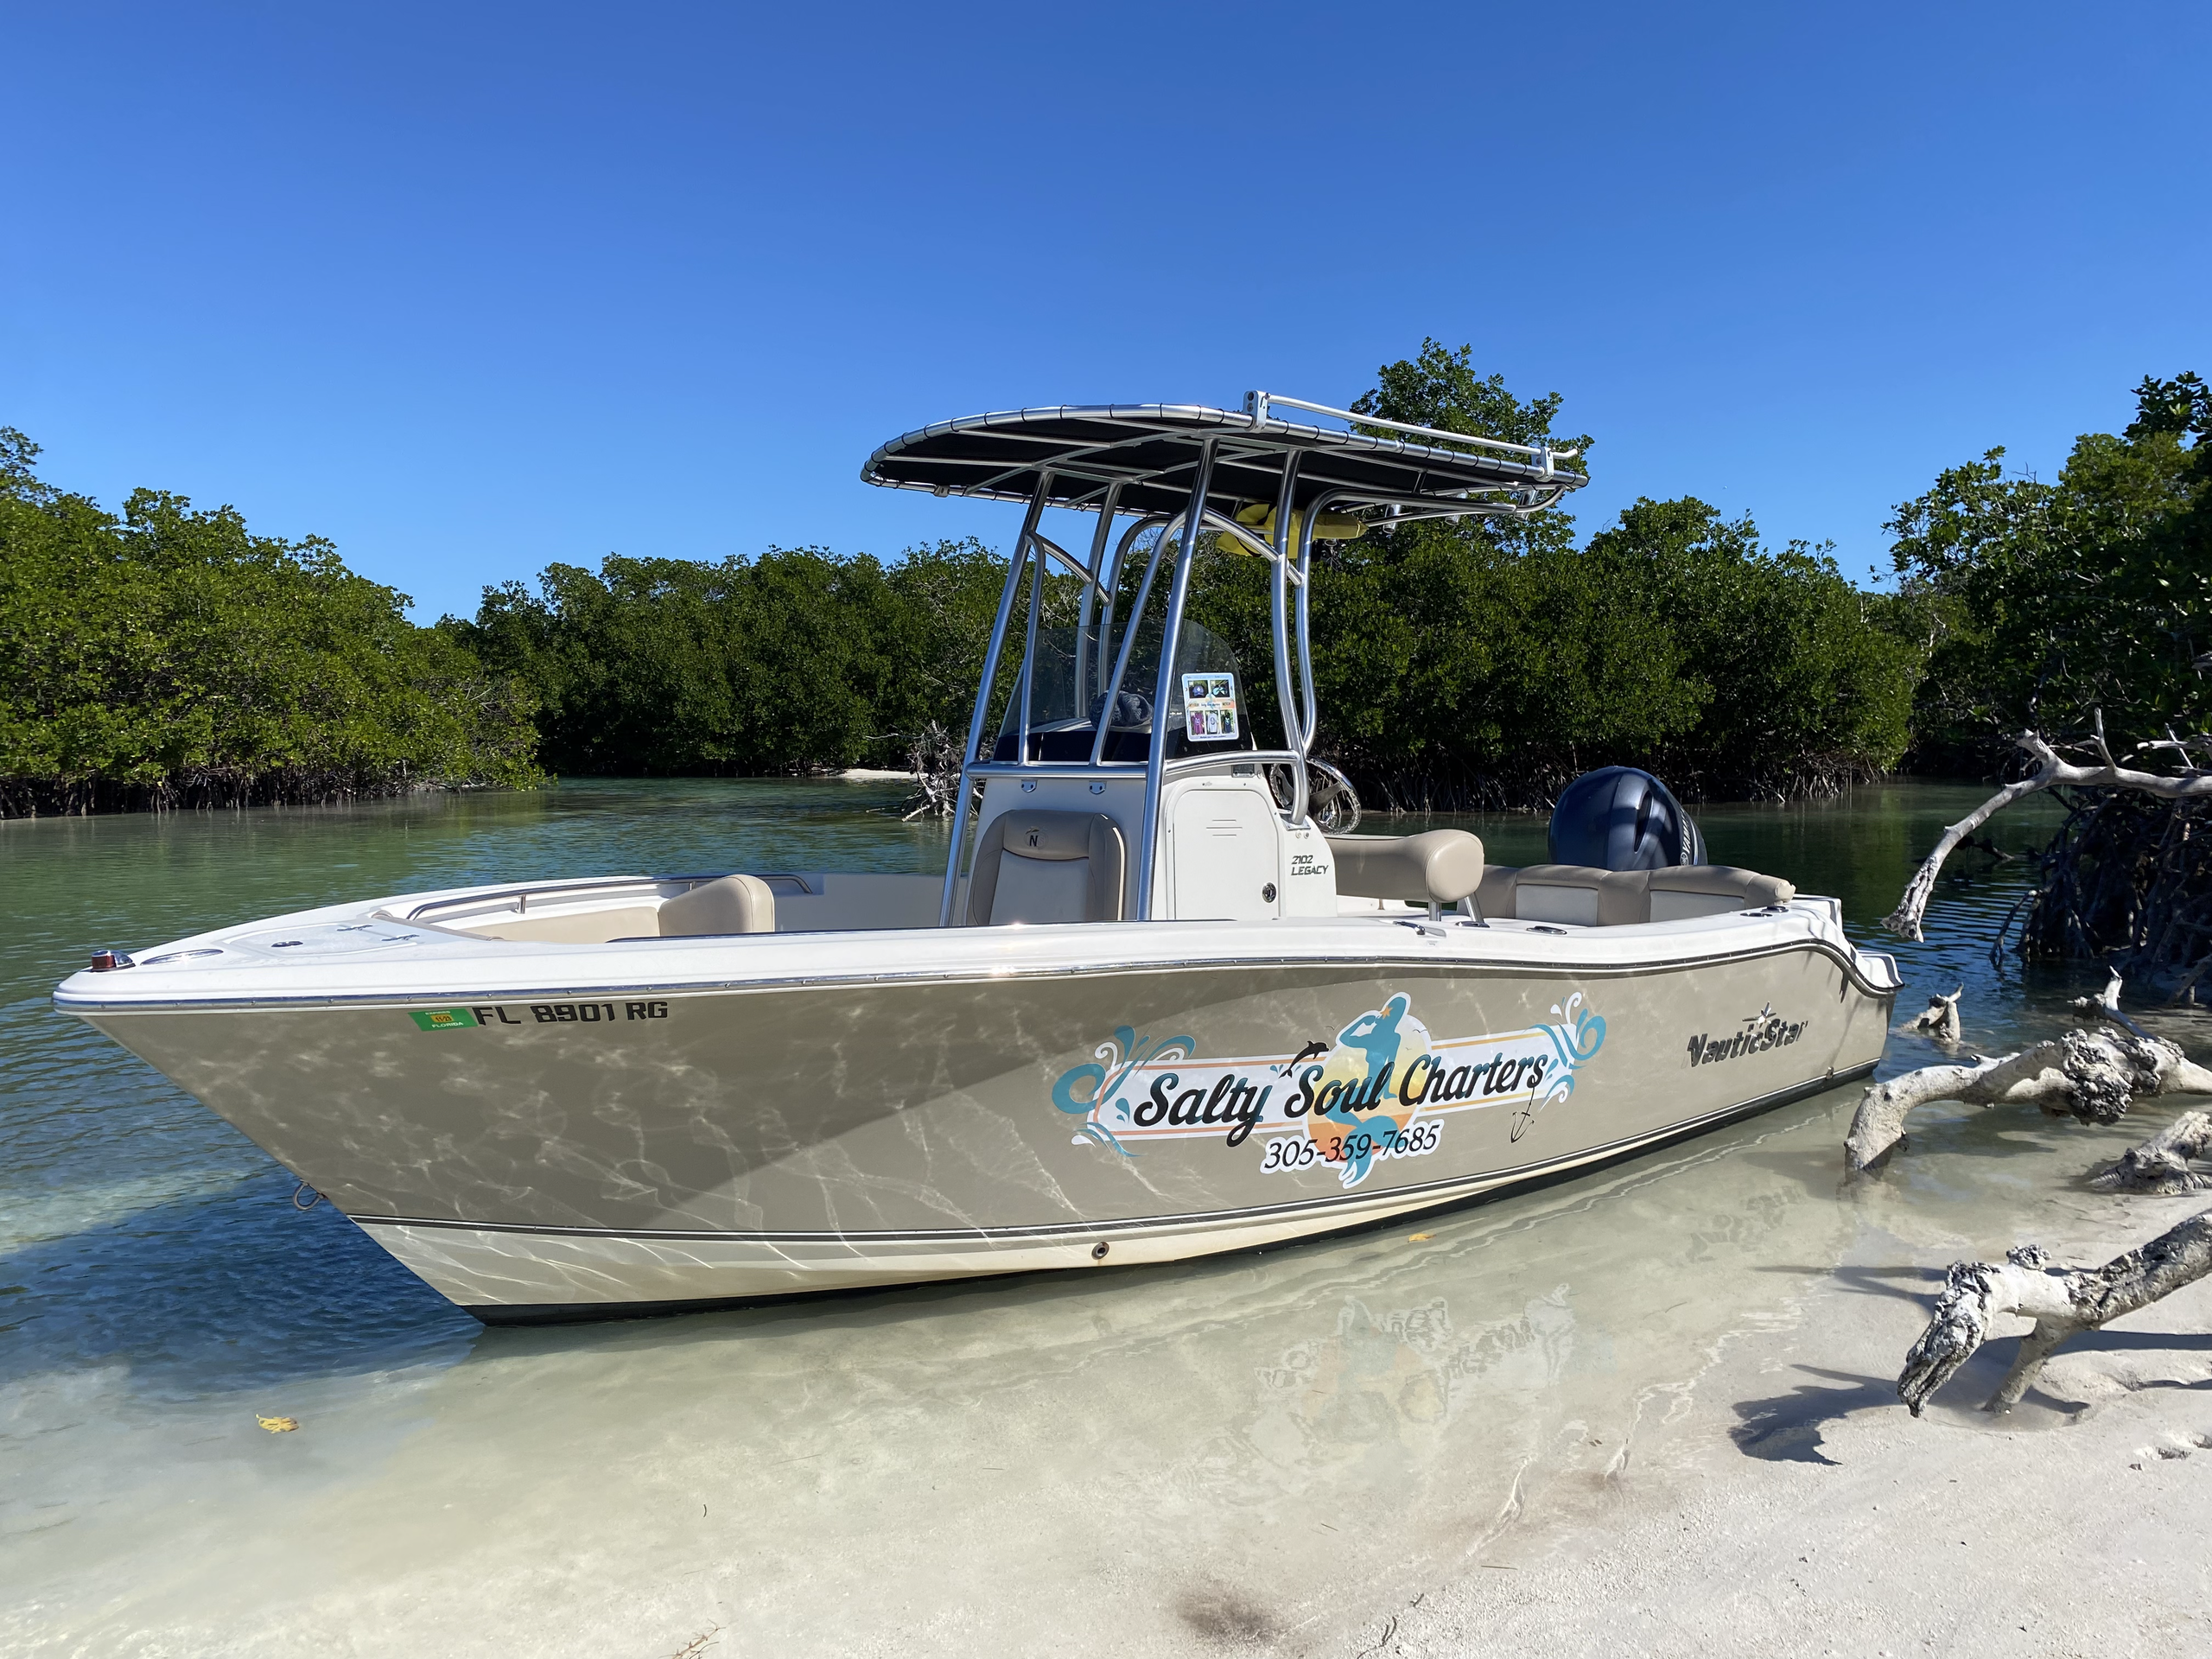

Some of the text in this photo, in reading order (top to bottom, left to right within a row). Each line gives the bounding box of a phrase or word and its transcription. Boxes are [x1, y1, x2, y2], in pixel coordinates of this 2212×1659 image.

[1291, 855, 1313, 865] 2102
[1291, 865, 1329, 876] LEGACY
[472, 1001, 668, 1026] FL 8901 RG
[1687, 1018, 1808, 1068] NauticStar
[1134, 1052, 1548, 1147] Salty Soul Charters
[1264, 1124, 1440, 1169] 305-359-7685
